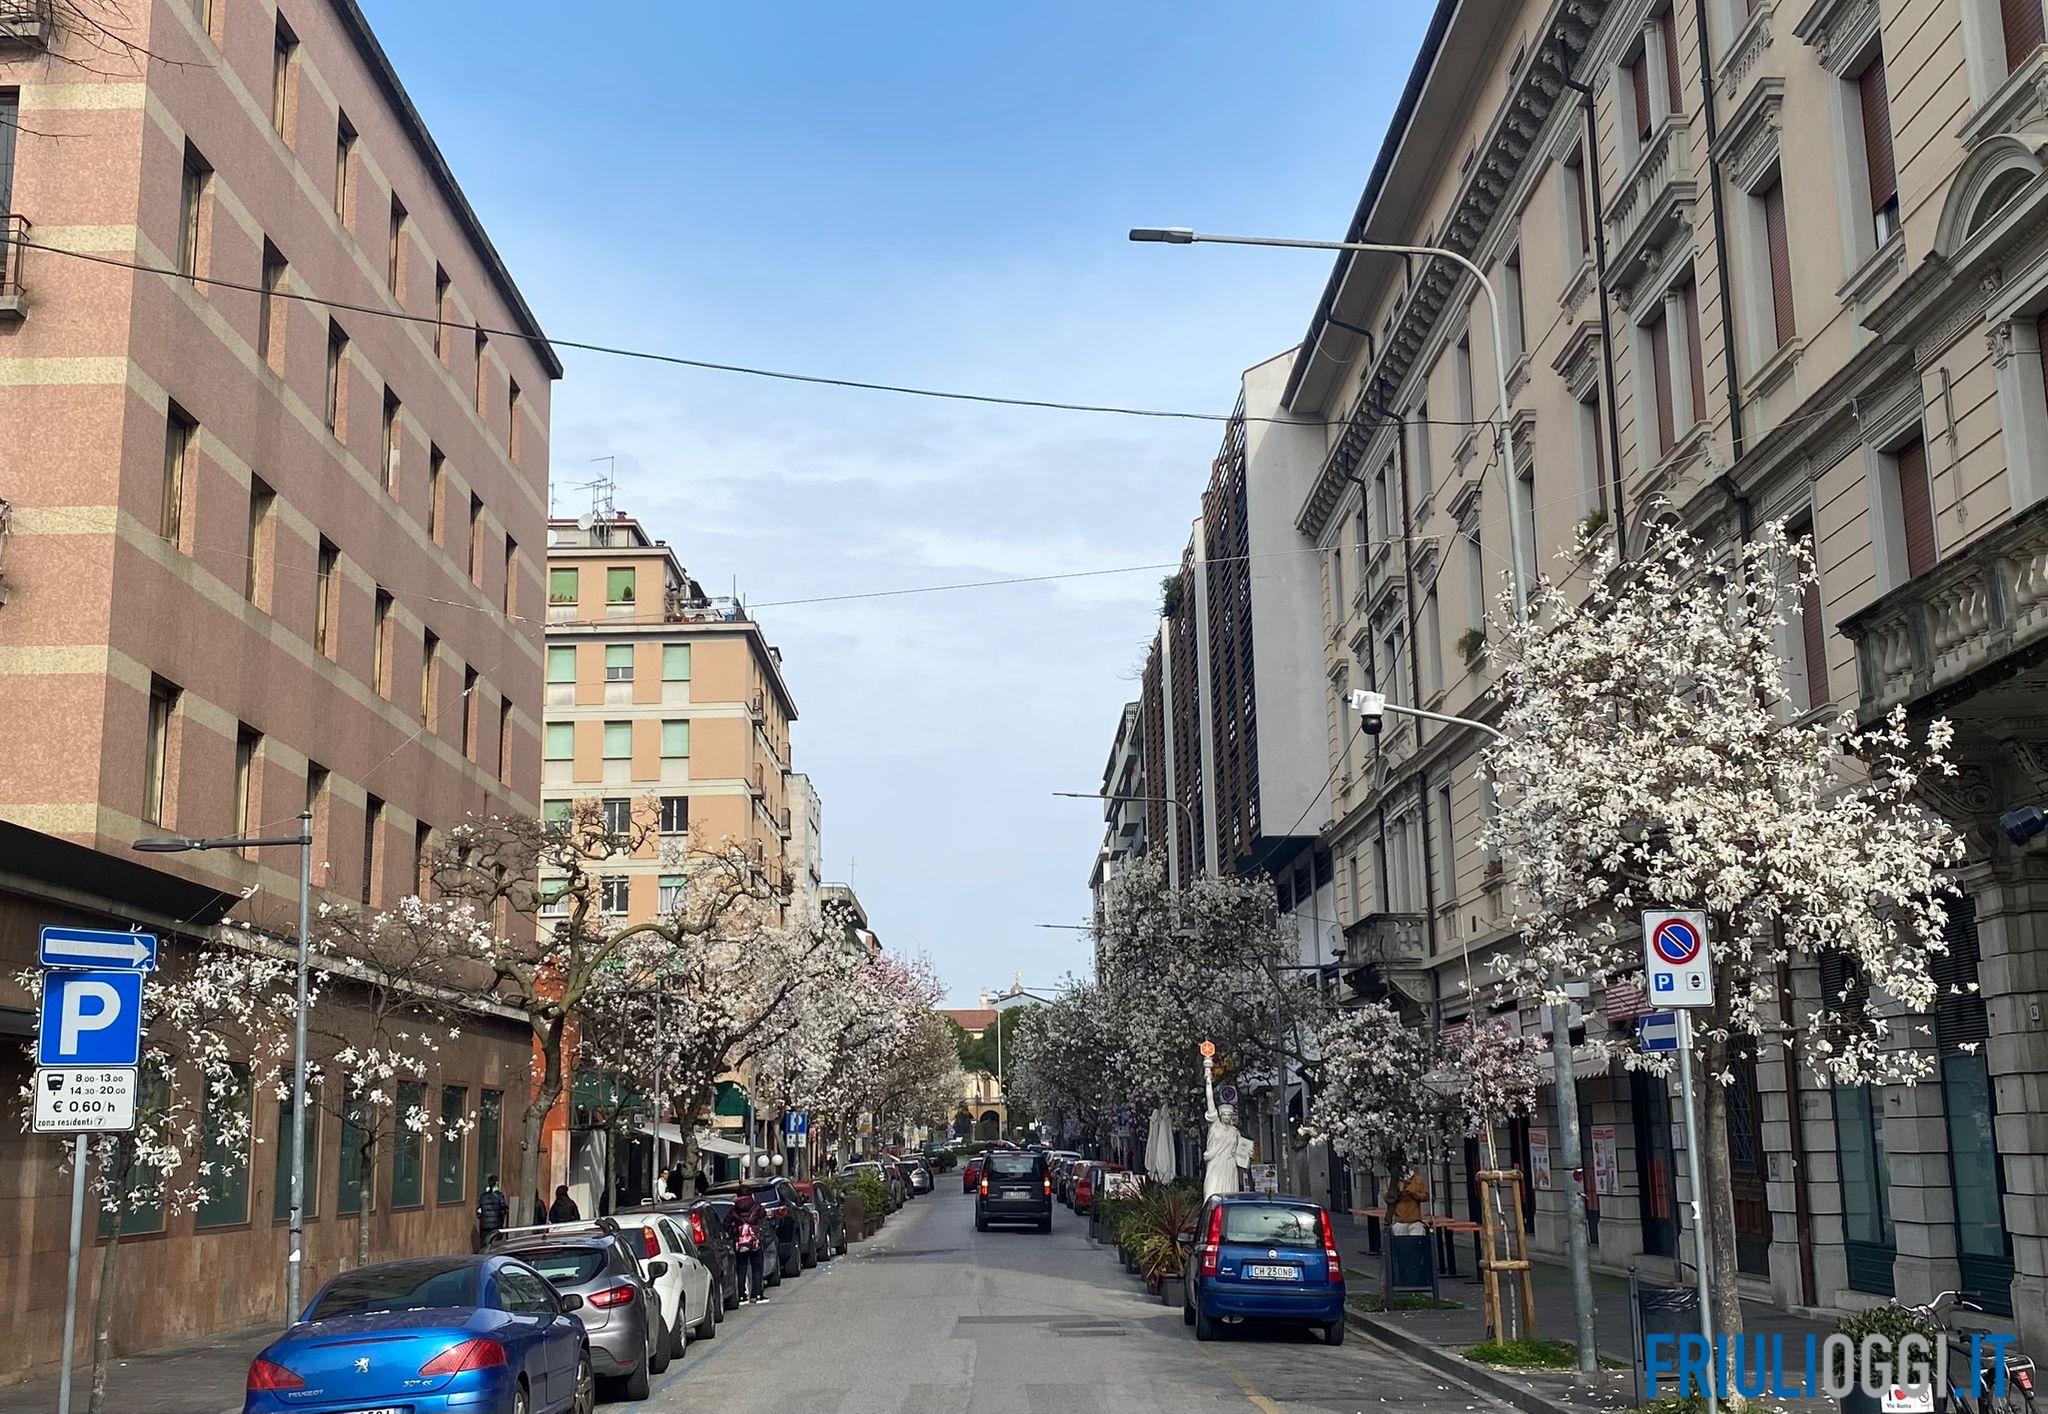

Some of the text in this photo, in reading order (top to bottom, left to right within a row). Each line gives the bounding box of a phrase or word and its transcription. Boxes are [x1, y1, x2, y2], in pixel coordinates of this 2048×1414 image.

[1658, 975, 1670, 990] P
[59, 981, 121, 1055] P
[52, 1100, 64, 1113] €
[57, 1117, 93, 1126] residenti
[790, 1113, 803, 1132] P
[288, 1389, 325, 1398] PEUGEOT
